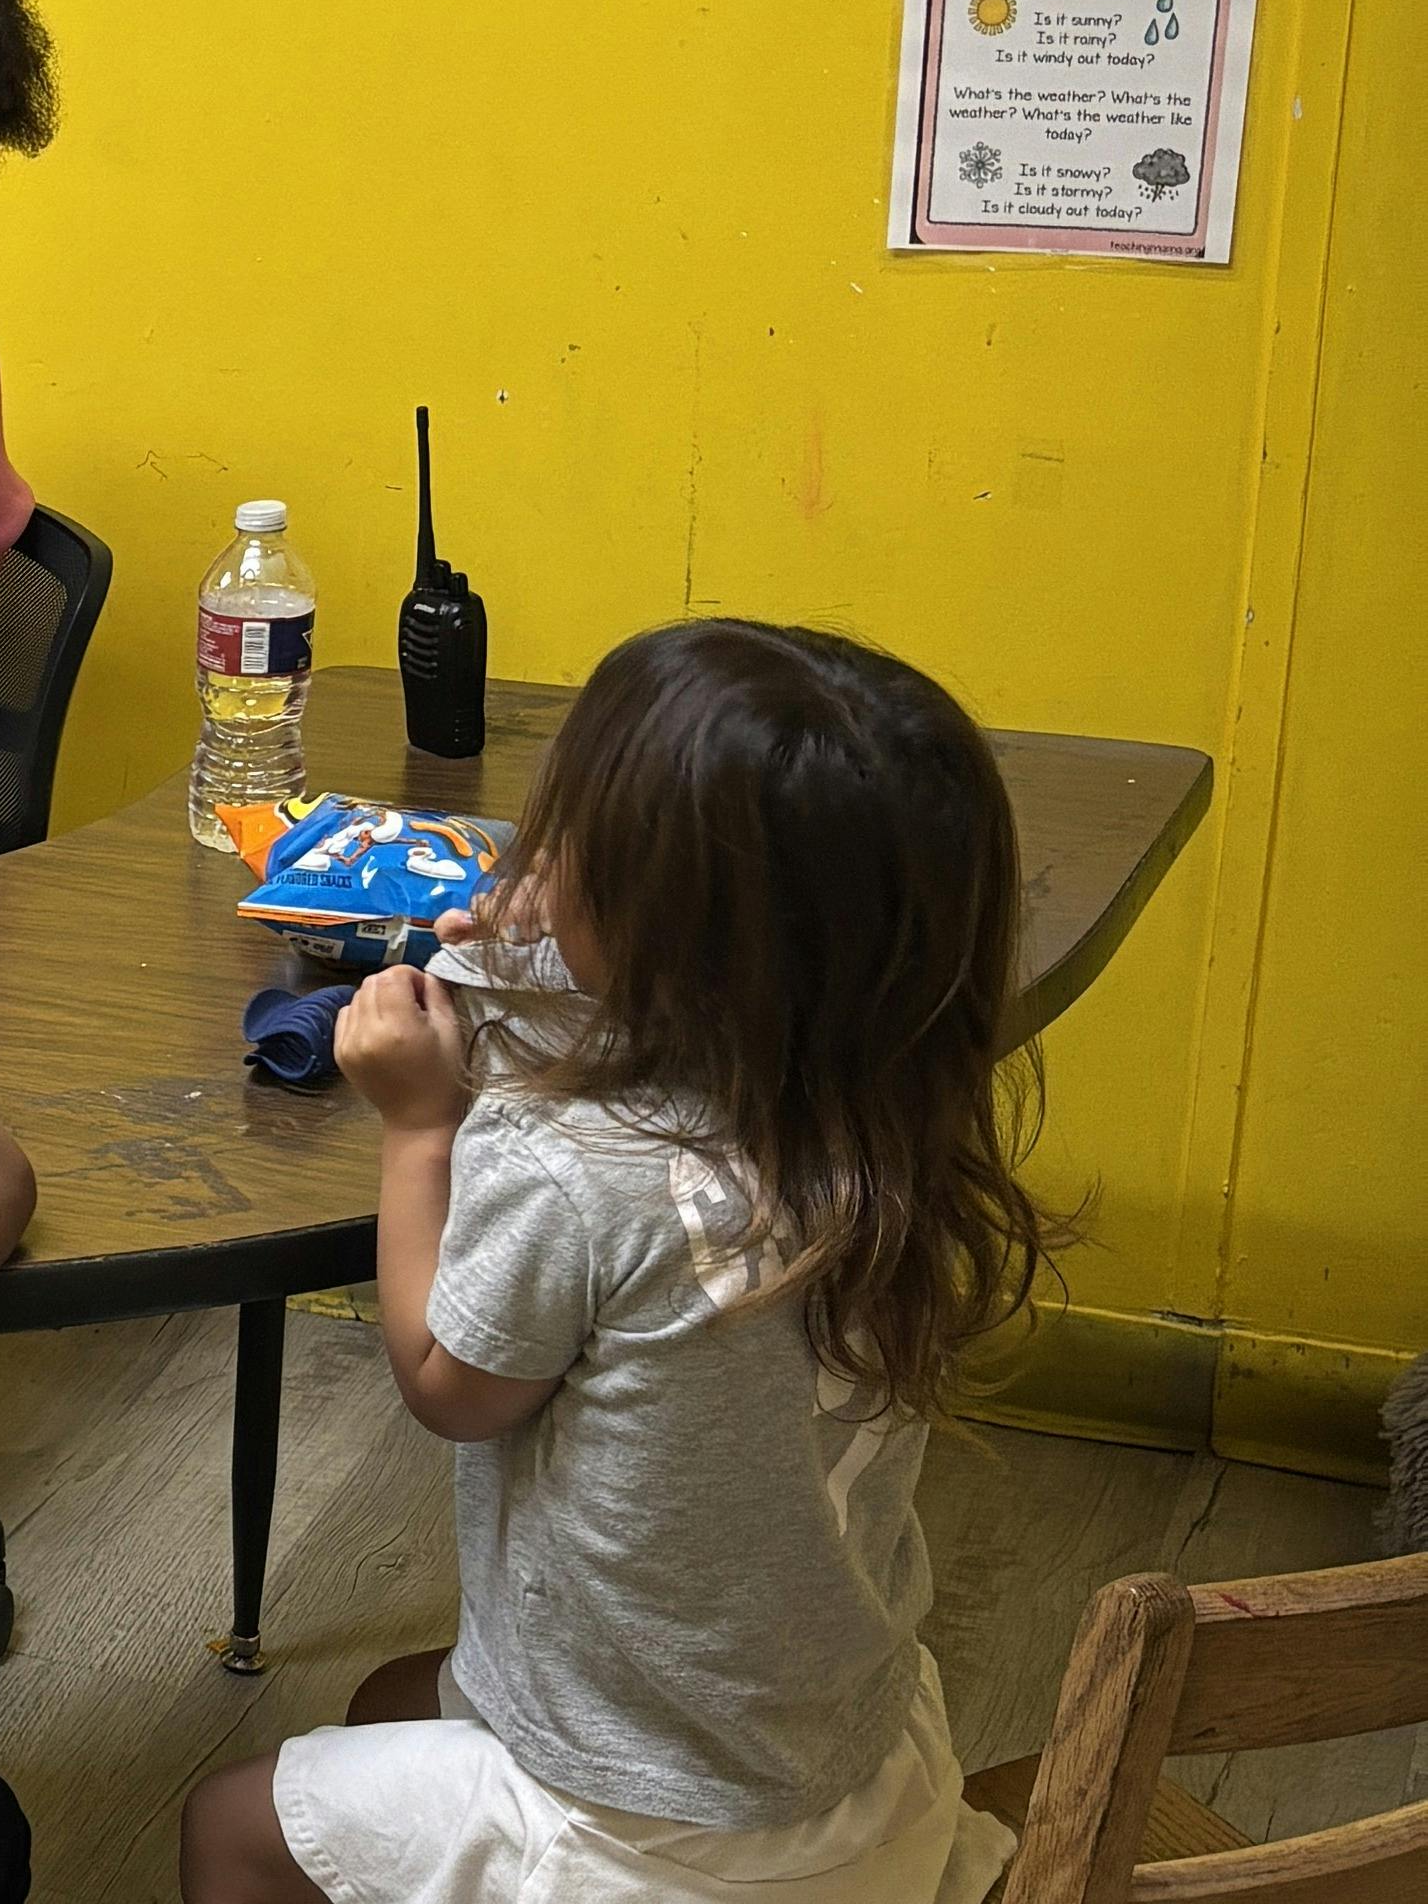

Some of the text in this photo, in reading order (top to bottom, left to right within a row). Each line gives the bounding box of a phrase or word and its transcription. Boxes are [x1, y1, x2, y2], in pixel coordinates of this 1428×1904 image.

[1033, 11, 1123, 30] Is it sunny?
[1036, 31, 1117, 49] Is it rainy?
[995, 49, 1155, 70] Is it windy out today?
[953, 86, 1192, 107] What's the weather? What's the
[948, 106, 1018, 119] weather?
[1022, 107, 1072, 121] What's
[1077, 109, 1101, 123] the
[1106, 111, 1165, 125] weather
[1045, 127, 1093, 144] today?
[1018, 163, 1111, 182] Is it snowy?
[1013, 182, 1113, 202] Is it stormy?
[981, 199, 1143, 223] Is it cloudy out today?
